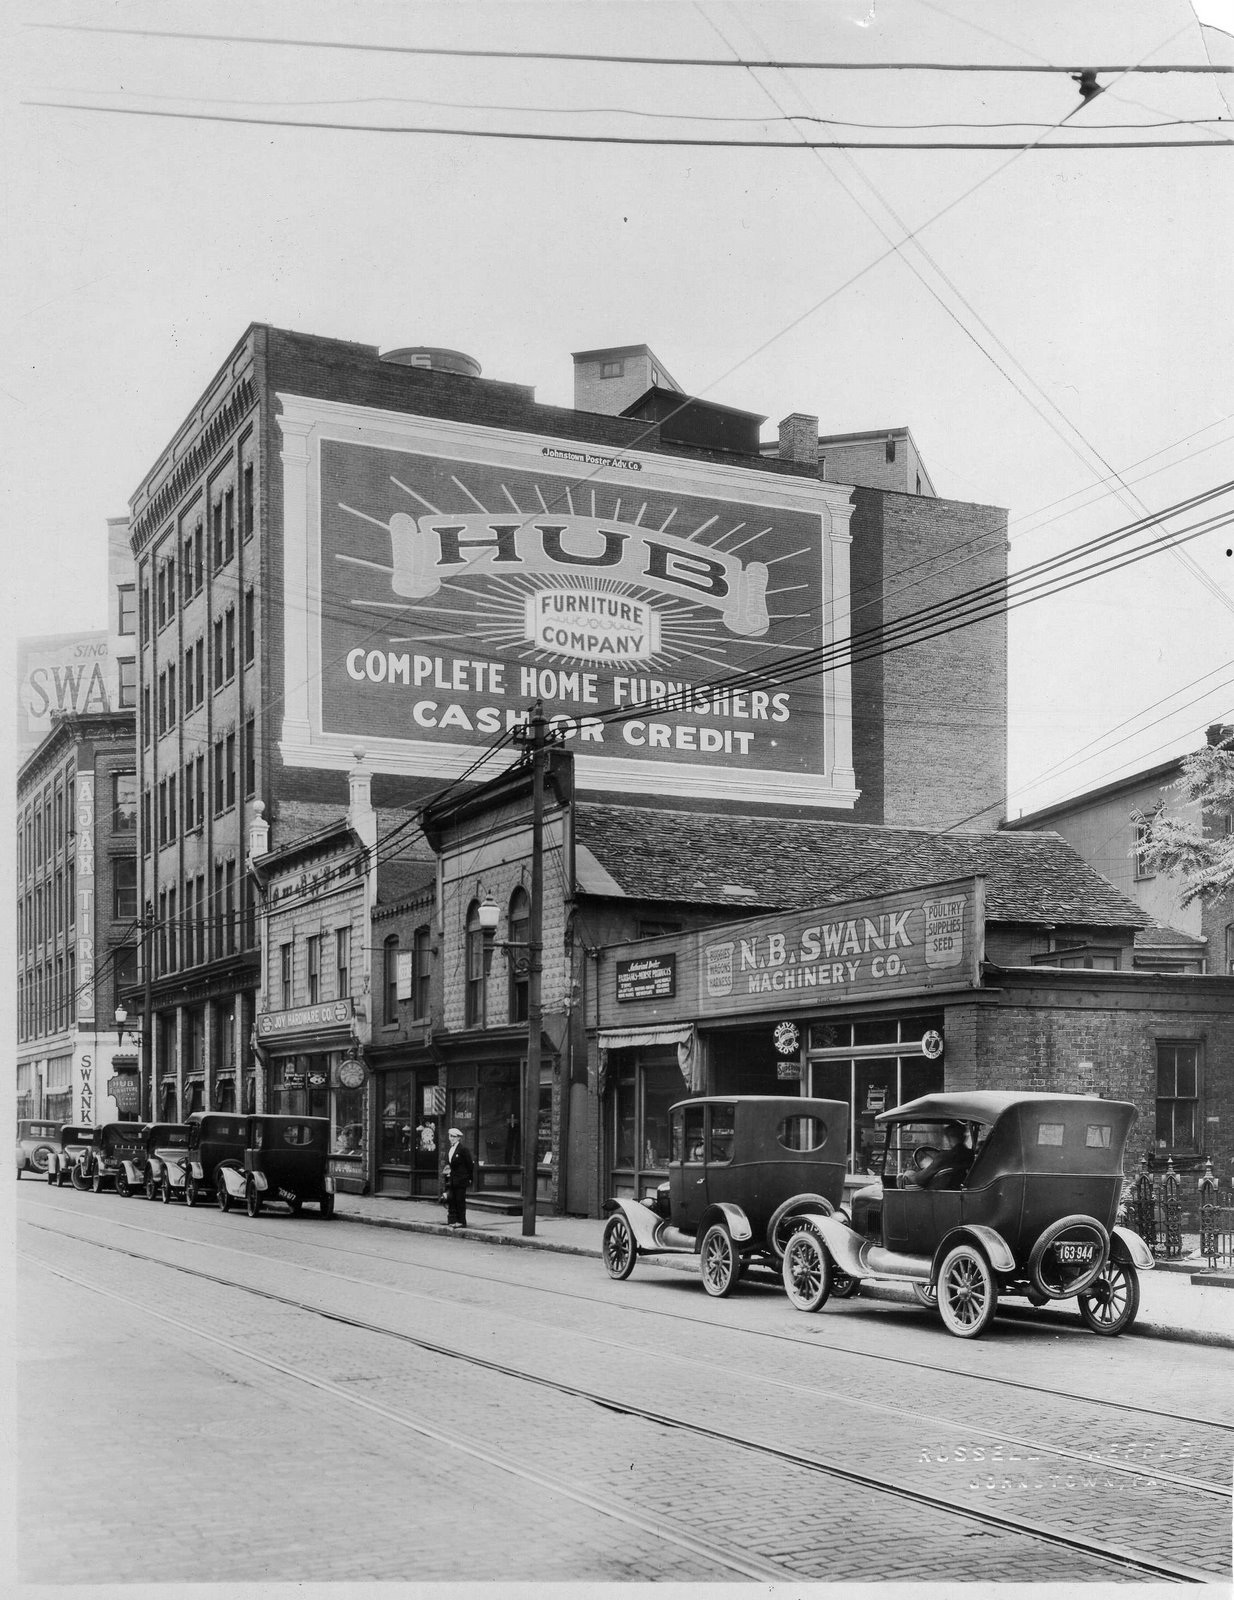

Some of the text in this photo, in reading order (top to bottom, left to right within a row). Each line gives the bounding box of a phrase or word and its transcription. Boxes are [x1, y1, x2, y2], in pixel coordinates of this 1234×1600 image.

[544, 448, 584, 462] Johnstown
[585, 454, 611, 466] Poster
[431, 525, 729, 598] HUB
[541, 595, 643, 625] FURNITURE
[542, 626, 644, 654] COMPANY
[346, 648, 790, 722] COMPLETE HOME FURNISHERS
[412, 700, 755, 755] CASH OR CREDIT
[78, 781, 94, 875] AJAX
[929, 902, 960, 919] POULTRY
[929, 919, 960, 936] SUPPLIES
[78, 889, 94, 1011] TIRES
[933, 937, 953, 952] SEED
[749, 954, 908, 994] MACHINERY CO.
[274, 1014, 286, 1028] JOY
[288, 1009, 319, 1026] HARDWARE
[80, 1055, 93, 1122] SWANK
